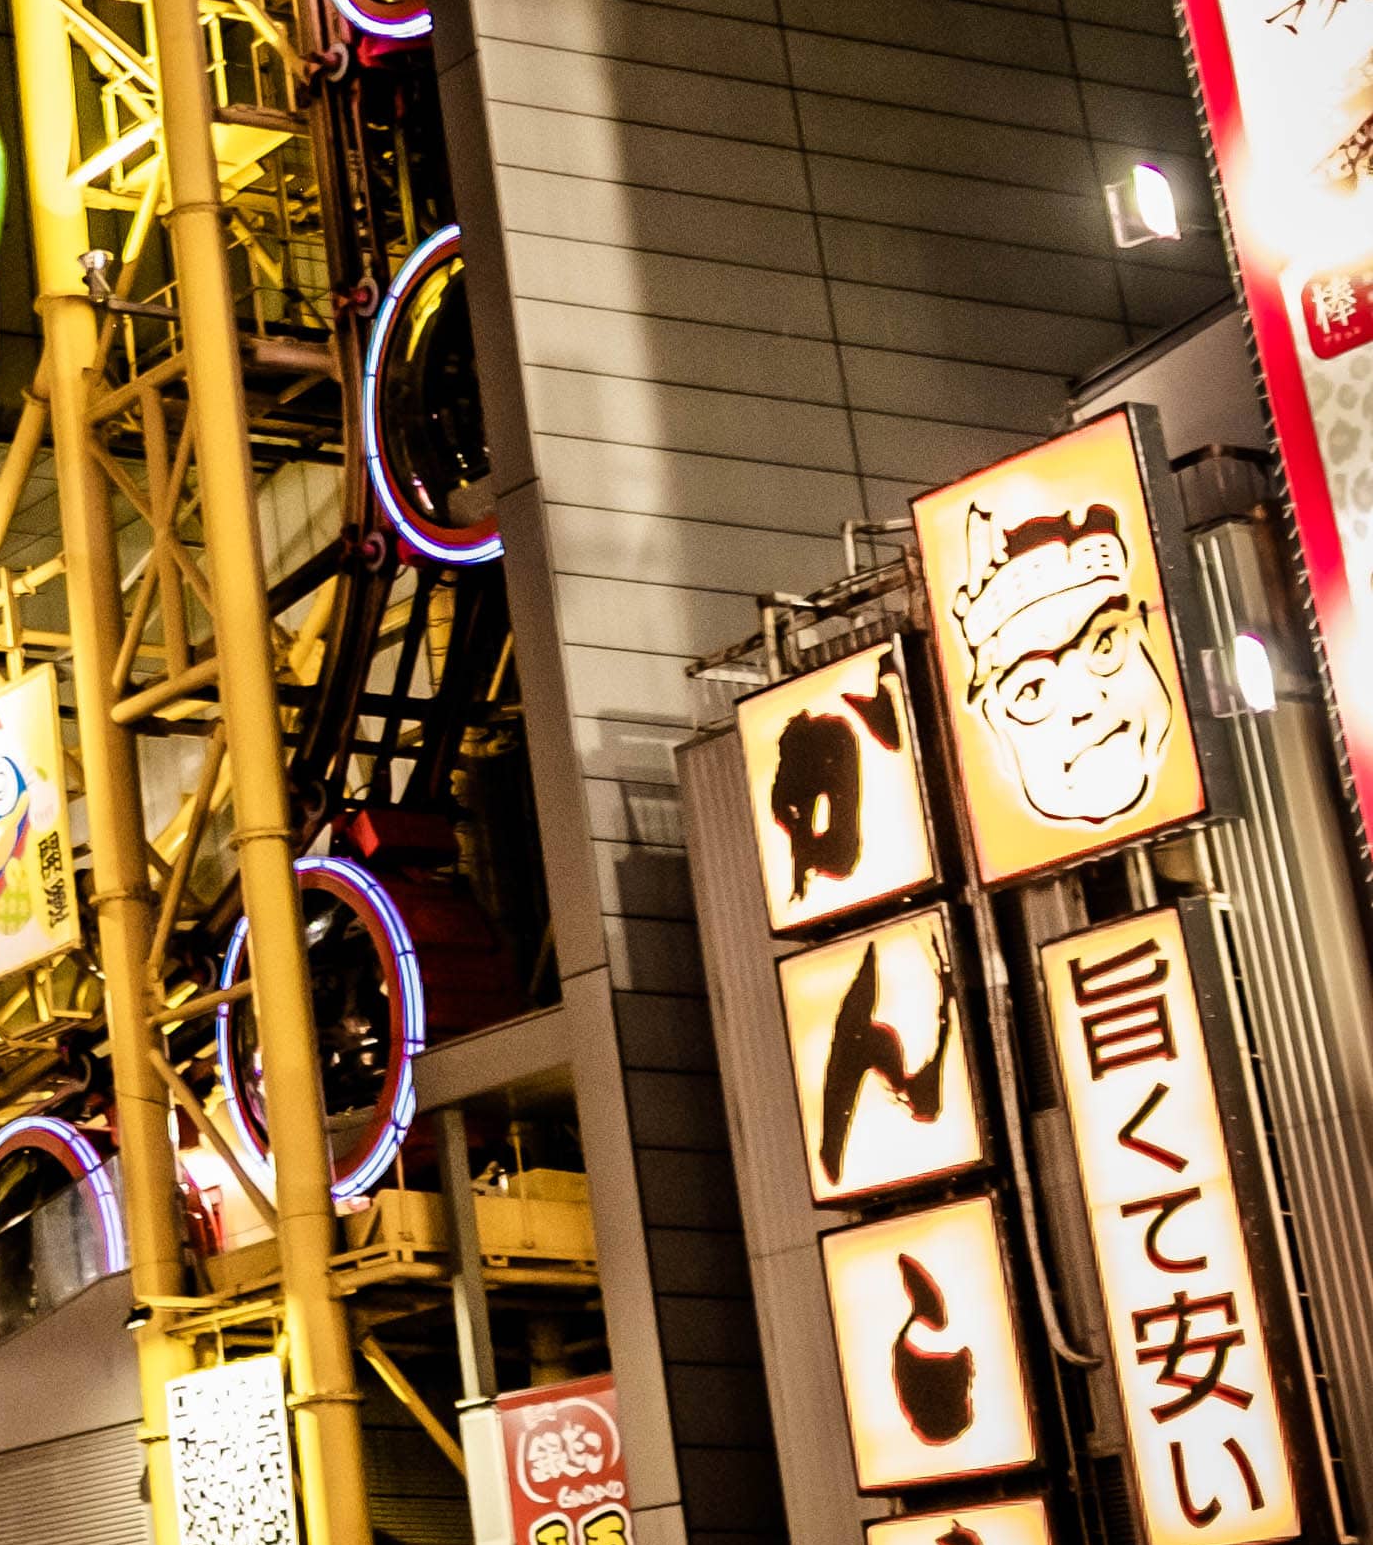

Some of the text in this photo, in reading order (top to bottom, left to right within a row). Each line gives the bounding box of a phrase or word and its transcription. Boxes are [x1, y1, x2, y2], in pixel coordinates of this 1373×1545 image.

[1069, 936, 1265, 1529] 旨くて安い
